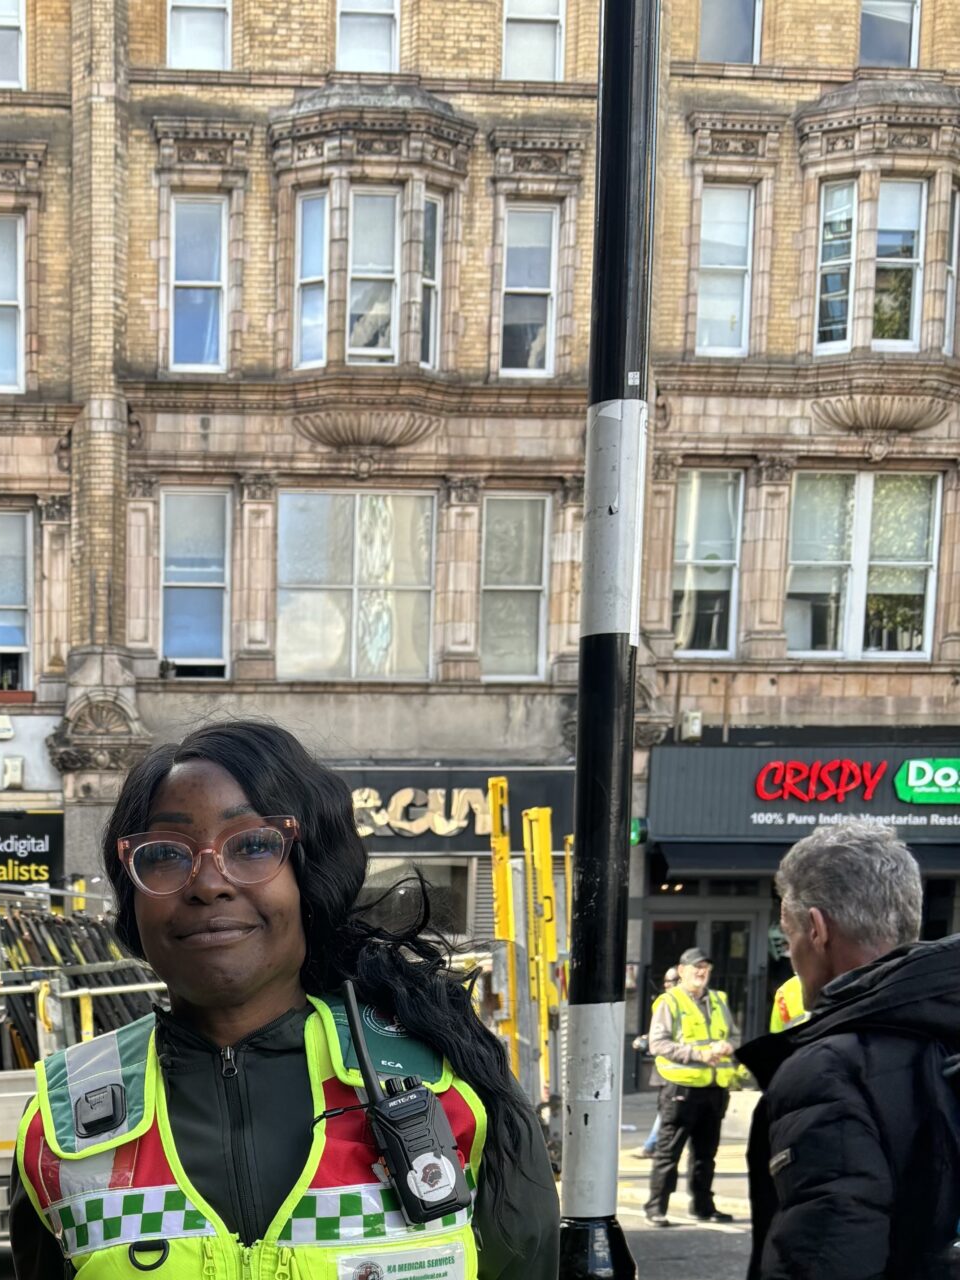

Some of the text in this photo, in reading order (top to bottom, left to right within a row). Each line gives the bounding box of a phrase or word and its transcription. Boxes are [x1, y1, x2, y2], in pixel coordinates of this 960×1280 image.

[755, 759, 888, 803] CRISPY
[908, 760, 960, 788] Do
[750, 812, 785, 825] 100%
[787, 812, 817, 825] Pure
[381, 1060, 404, 1070] ECA
[397, 1260, 426, 1273] MEDICAL
[426, 1255, 456, 1270] SERVICES
